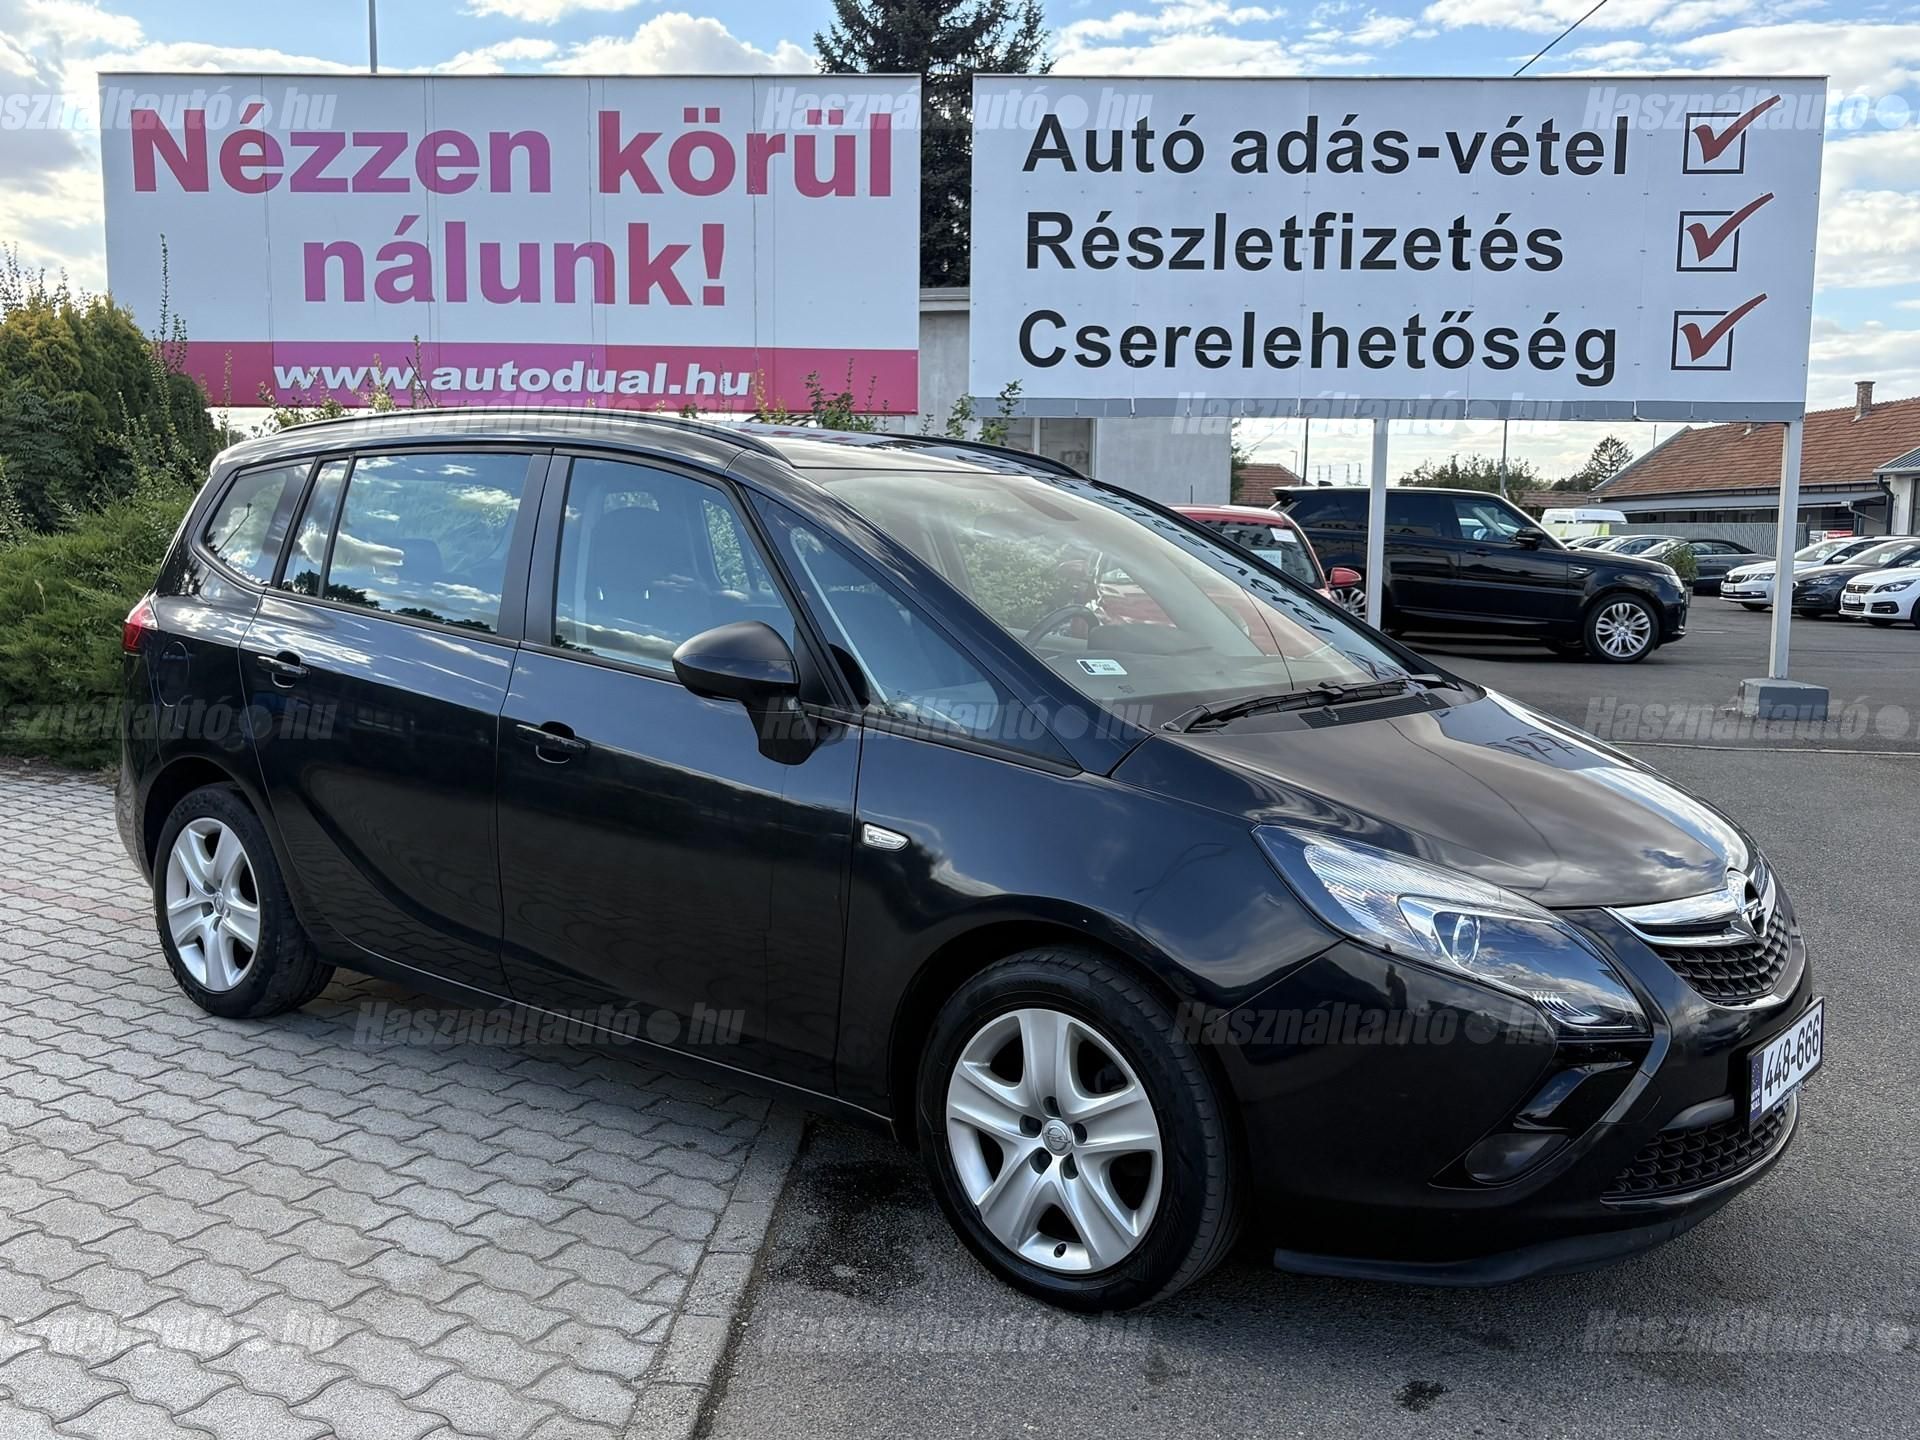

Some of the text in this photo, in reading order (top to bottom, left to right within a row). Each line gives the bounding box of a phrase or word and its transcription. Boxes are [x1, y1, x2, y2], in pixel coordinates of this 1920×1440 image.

[131, 103, 892, 198] Nézzen körül
[1022, 113, 1628, 177] Autó adás-vétel
[303, 214, 726, 307] nálunk!
[1026, 211, 1564, 273] Részletfizetés
[273, 361, 750, 396] www.autodual.hu
[1018, 309, 1618, 388] Cserelehetőség
[1764, 1014, 1820, 1097] 448-666
